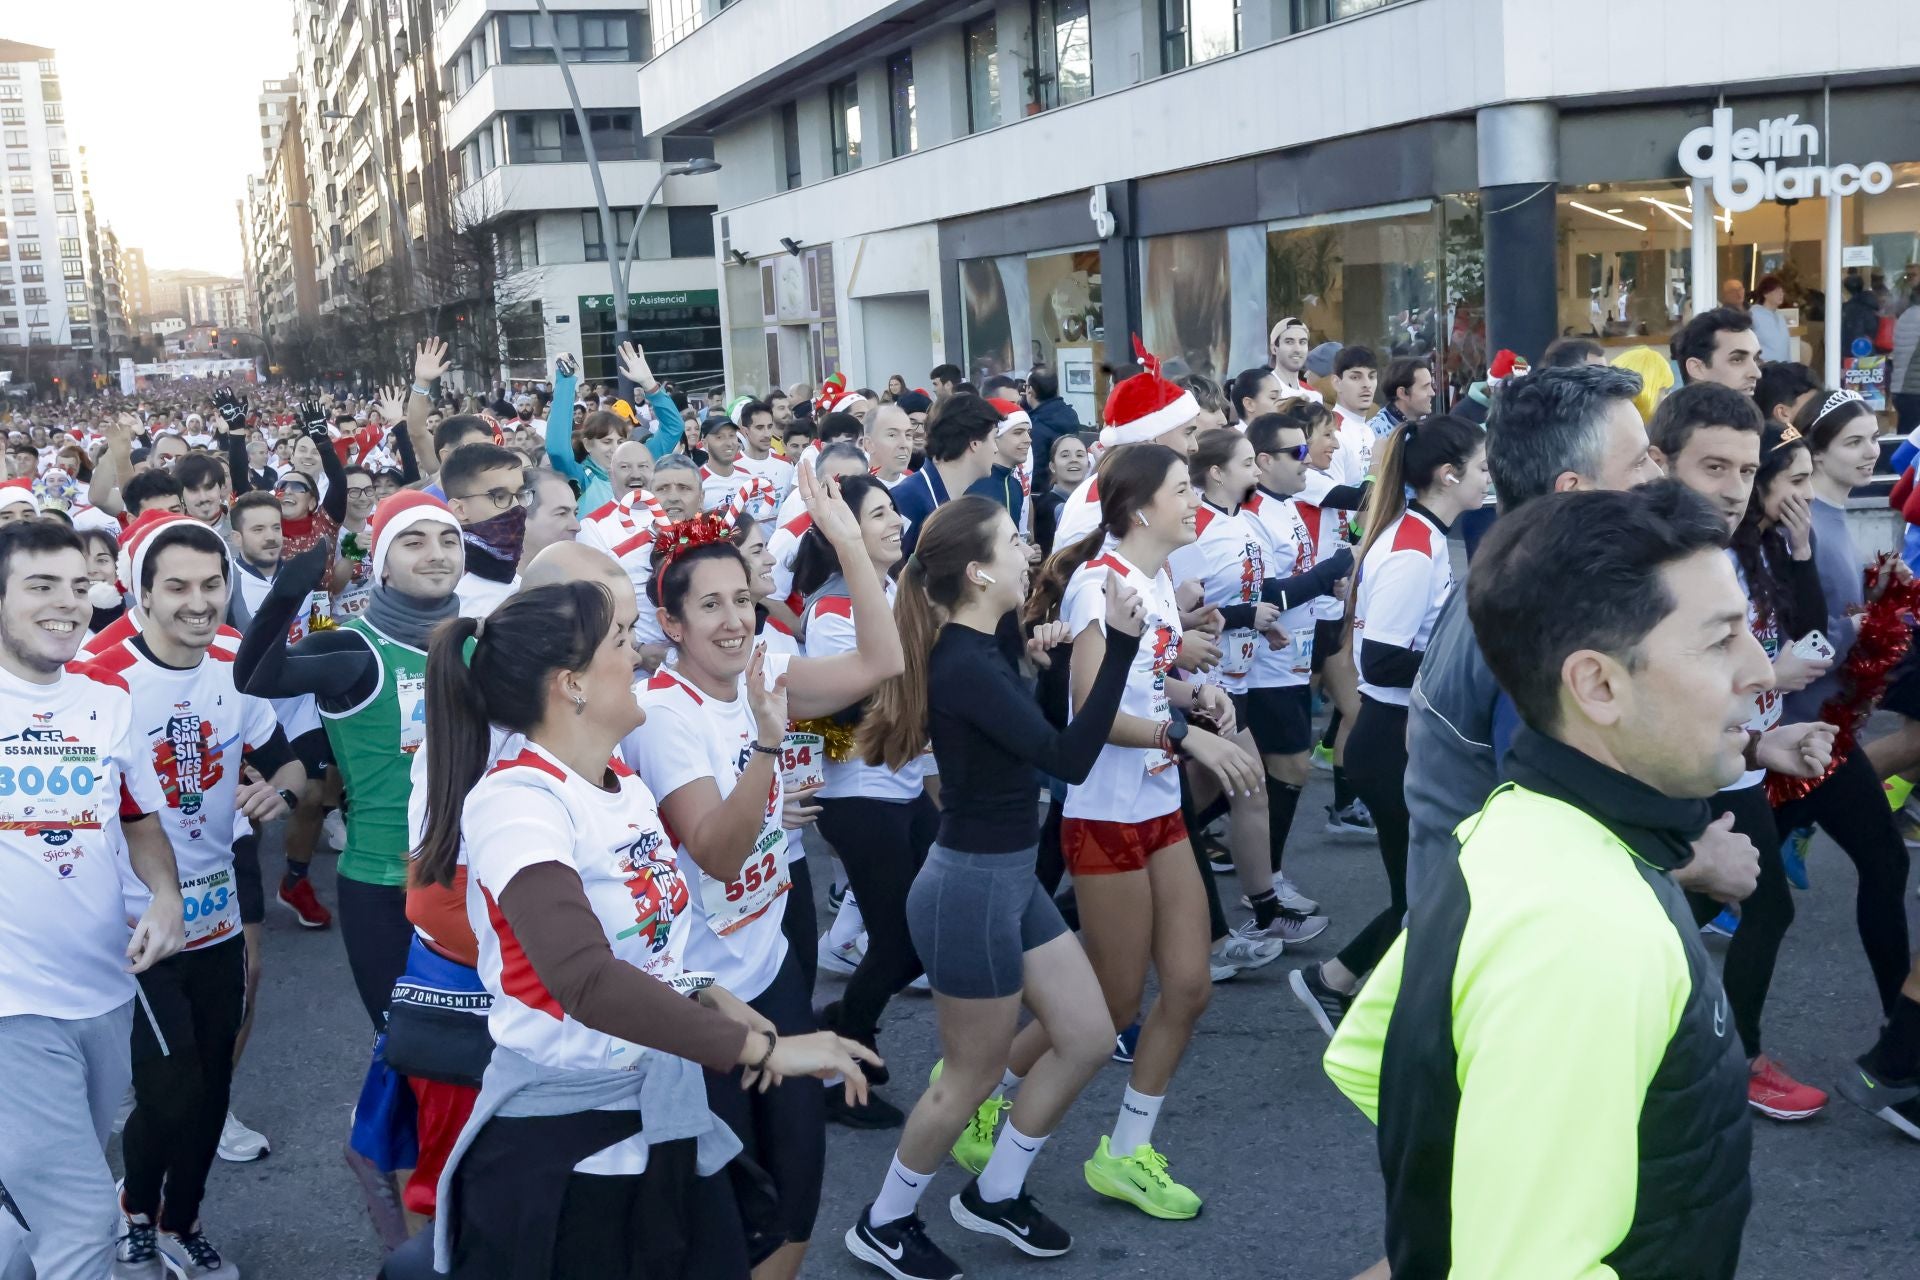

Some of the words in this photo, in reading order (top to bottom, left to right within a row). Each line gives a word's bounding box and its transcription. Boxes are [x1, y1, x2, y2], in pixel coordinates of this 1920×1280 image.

[1678, 107, 1819, 179] delfín
[1713, 160, 1893, 212] blanco
[606, 297, 637, 306] Cro
[640, 293, 687, 304] Asistencial
[1242, 642, 1253, 660] 92
[181, 717, 200, 732] 55
[172, 729, 200, 744] SAN
[5, 747, 19, 755] 55
[21, 747, 42, 755] SAN
[44, 747, 96, 755] SILVESTRE
[175, 743, 201, 760] SIL
[176, 759, 202, 776] VES
[0, 766, 95, 796] 3060
[175, 776, 202, 793] TRE
[43, 849, 71, 862] gijón
[197, 870, 228, 886] SILVESTRE
[726, 853, 777, 902] 552
[411, 991, 439, 1004] JOHN
[447, 996, 487, 1006] SMITH
[1124, 1103, 1148, 1116] didas
